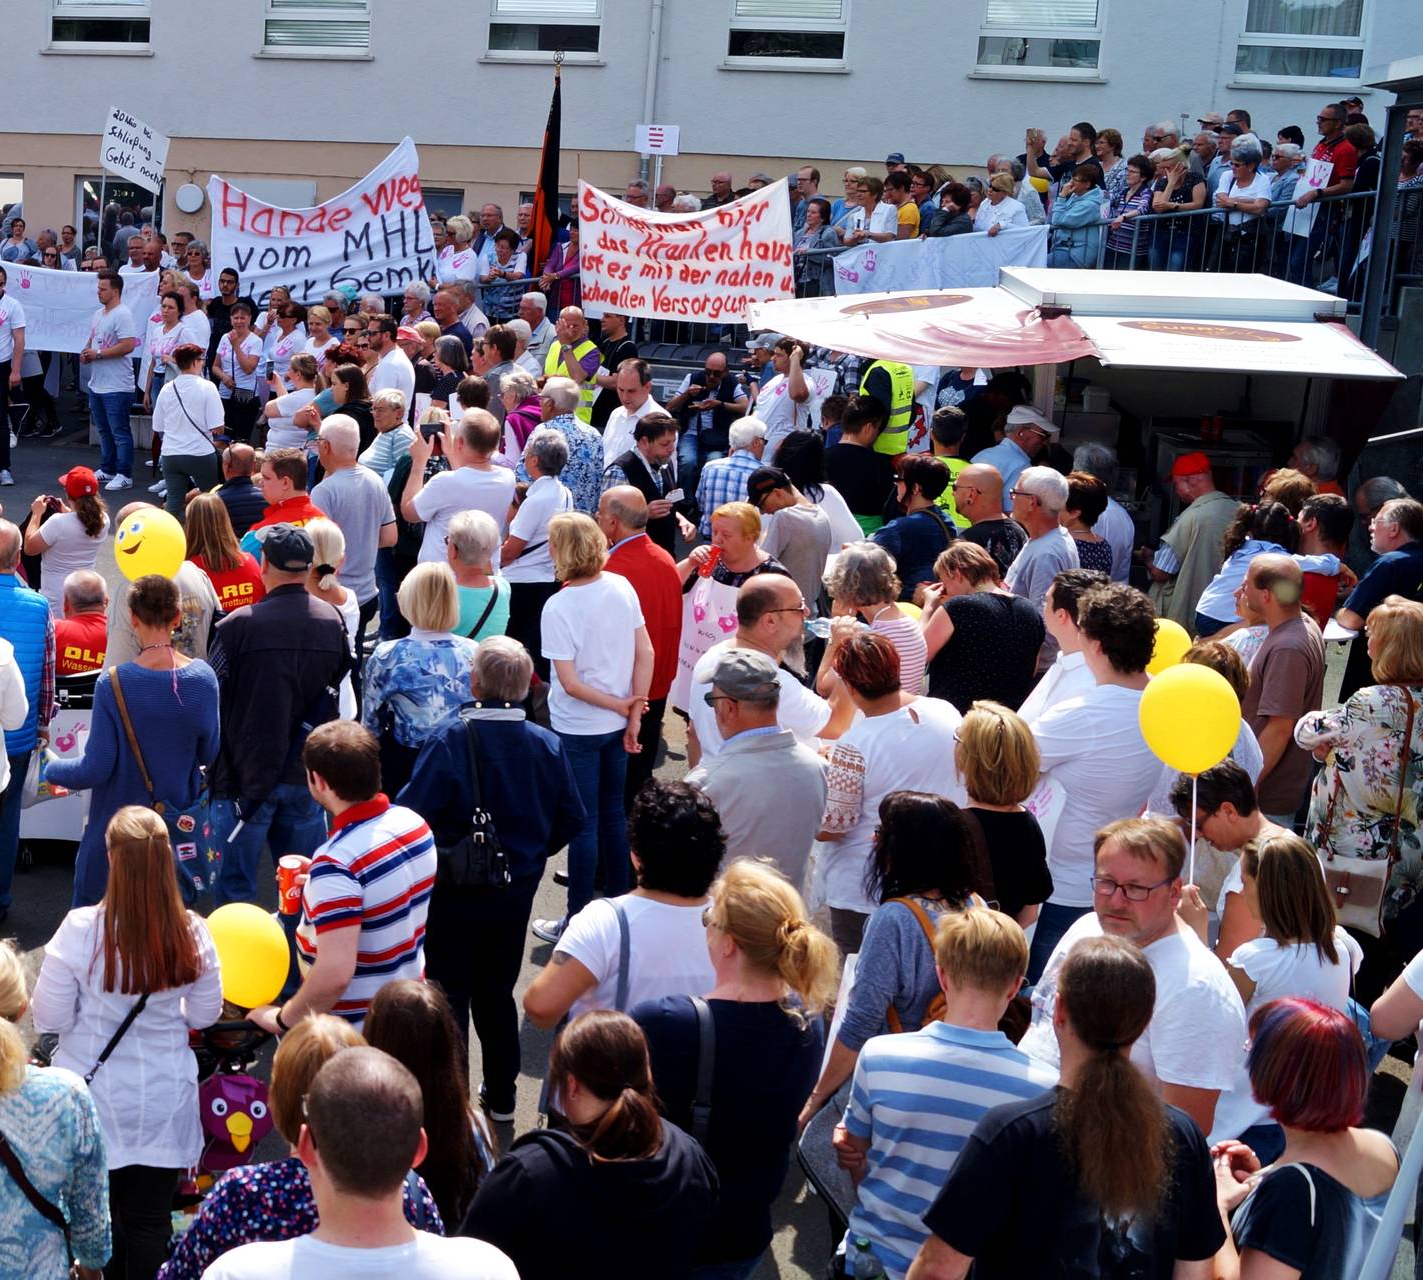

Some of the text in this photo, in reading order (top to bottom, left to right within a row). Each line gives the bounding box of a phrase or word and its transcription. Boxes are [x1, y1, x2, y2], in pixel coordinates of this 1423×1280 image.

[234, 208, 435, 273] vom MHL
[597, 231, 630, 254] das
[329, 256, 437, 294] Gemk
[581, 244, 604, 273] ist
[607, 260, 632, 281] es
[680, 263, 712, 286] der
[715, 263, 775, 288] nahen
